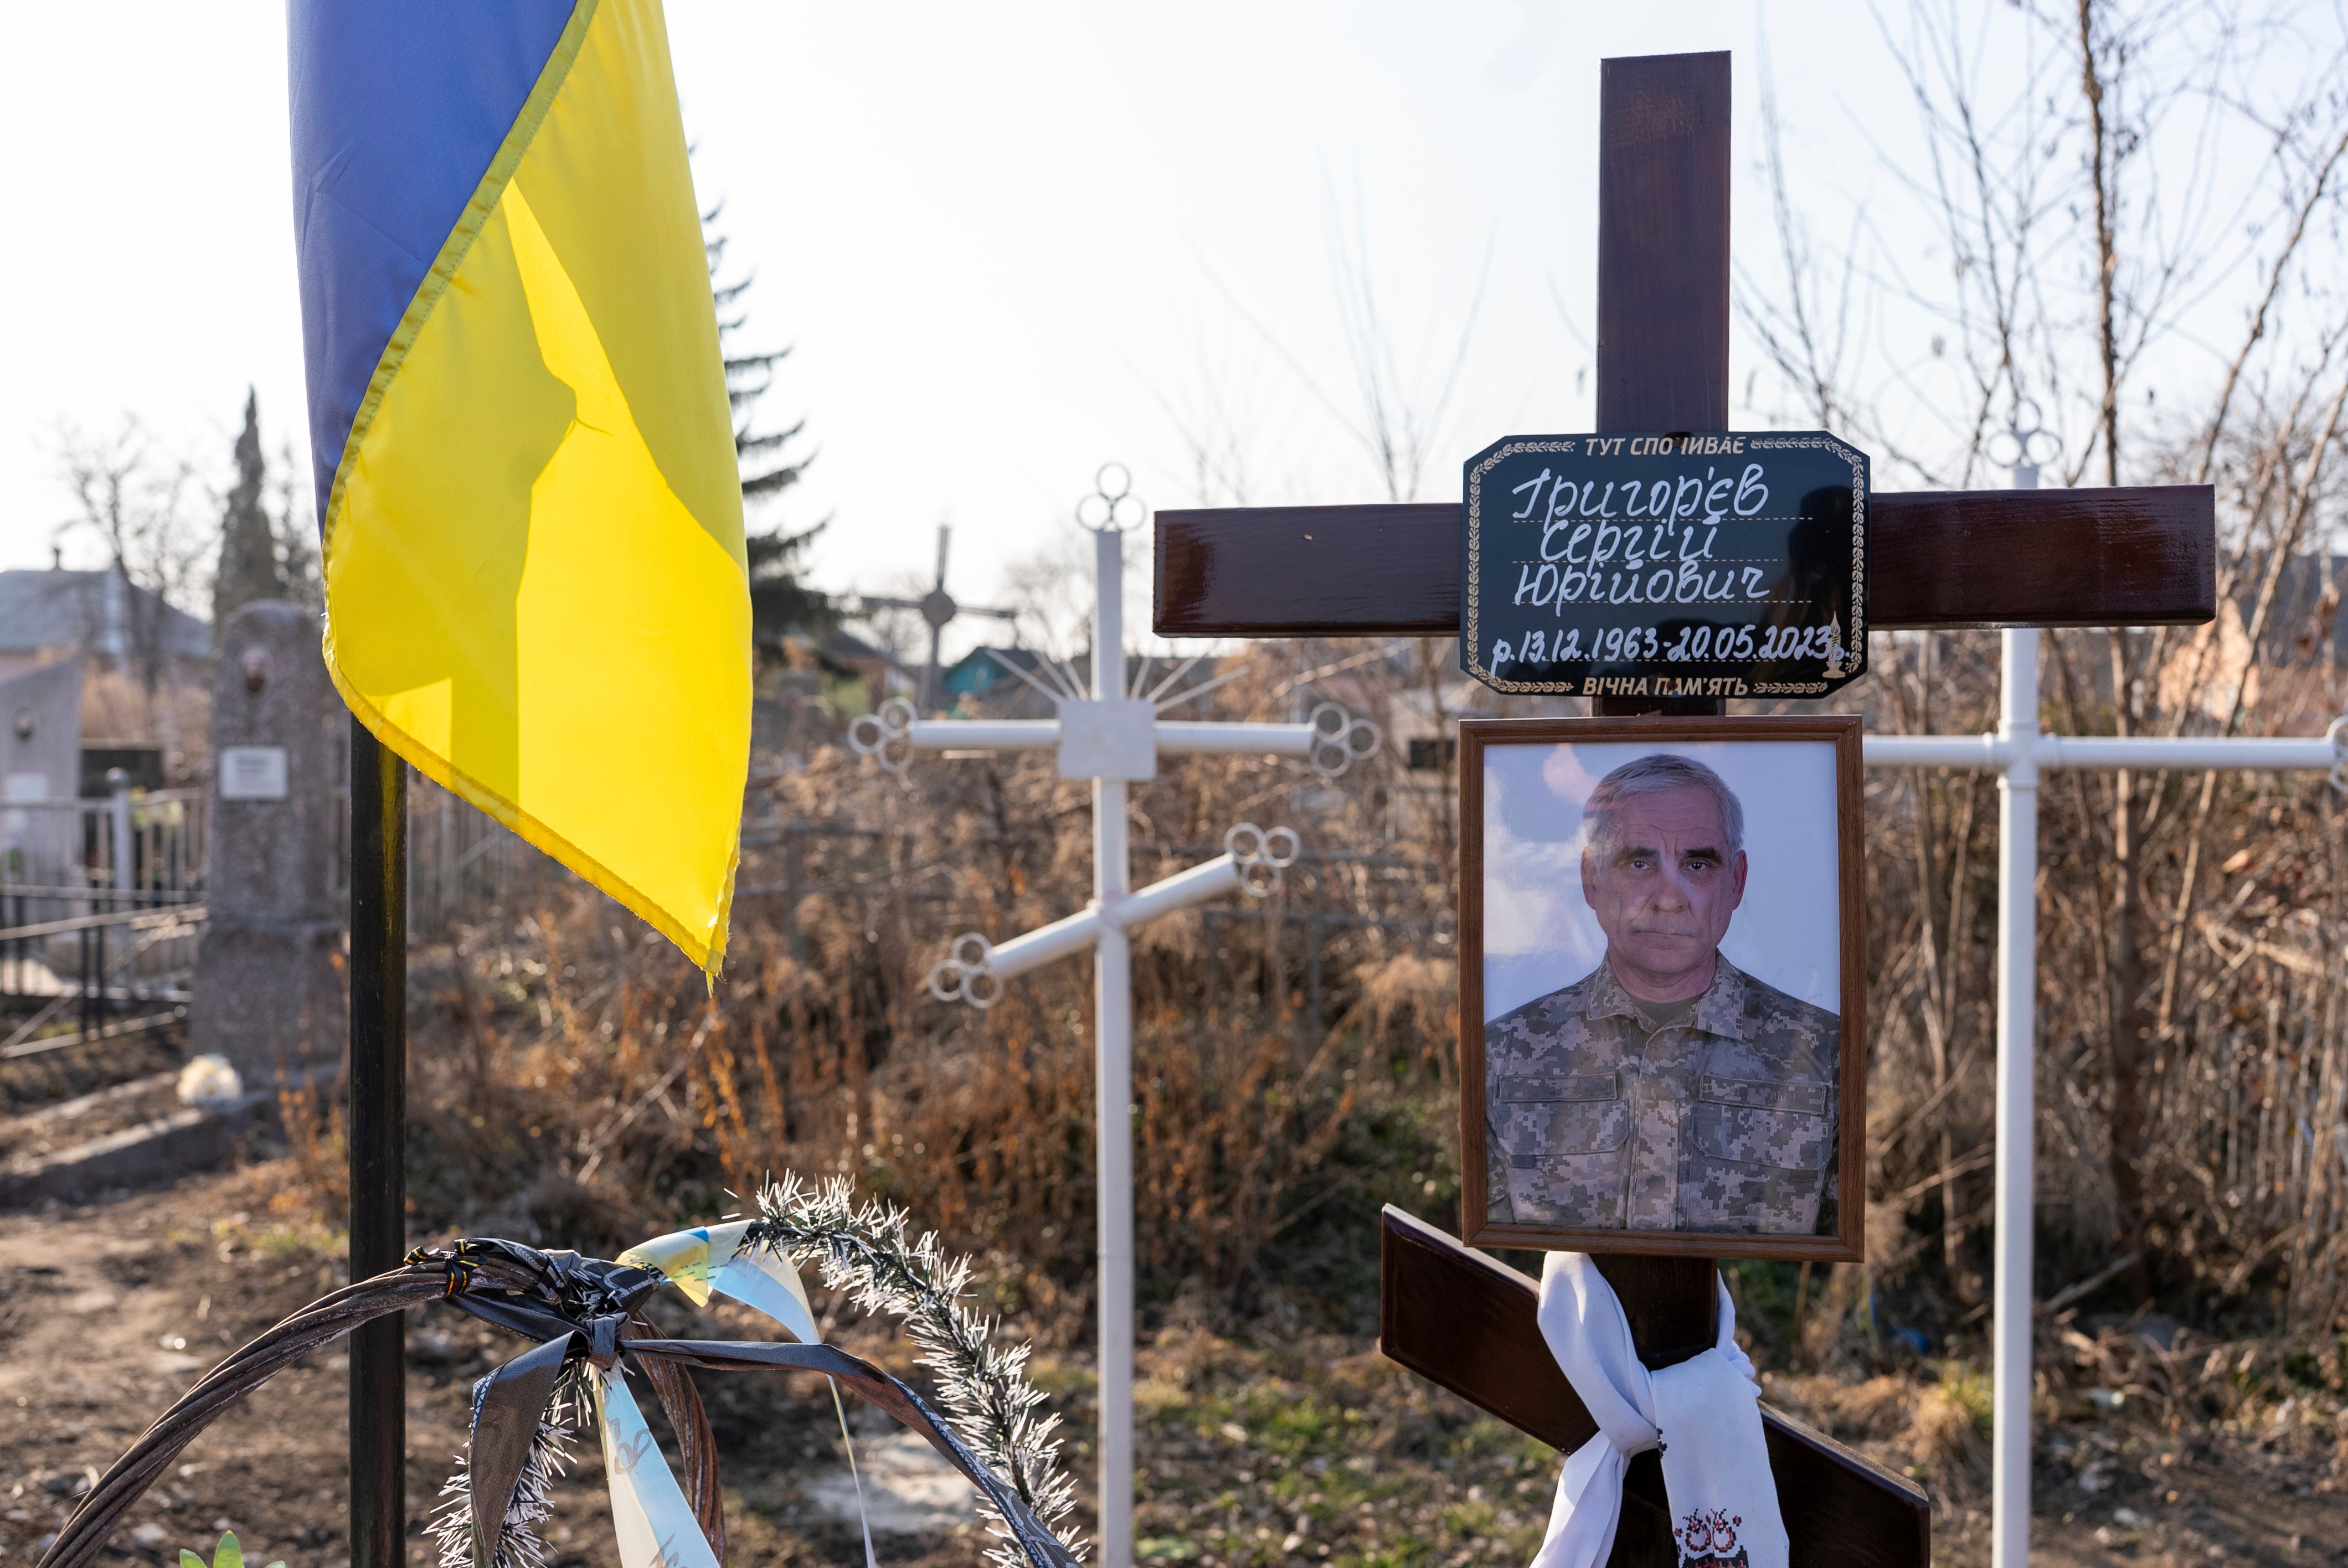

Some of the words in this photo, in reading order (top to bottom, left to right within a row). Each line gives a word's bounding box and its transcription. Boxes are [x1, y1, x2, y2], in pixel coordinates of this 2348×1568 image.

[1585, 437, 1626, 456] ТУТ
[1540, 514, 1721, 577] Сергій
[1514, 560, 1770, 617] Юрійович
[1583, 677, 1647, 695] ВІЧНА
[1654, 677, 1748, 696] ПАМ'ЯТЬ
